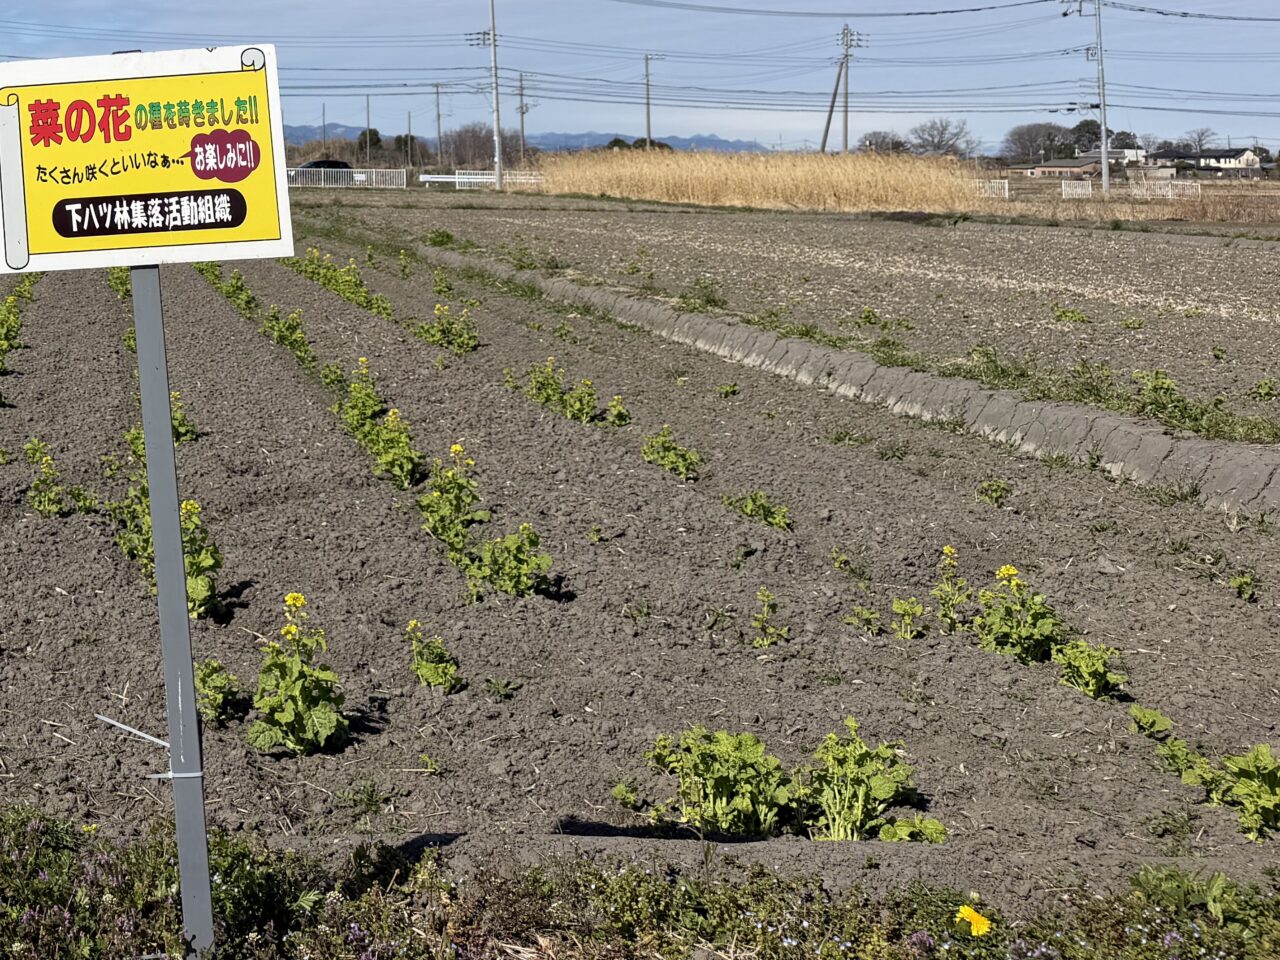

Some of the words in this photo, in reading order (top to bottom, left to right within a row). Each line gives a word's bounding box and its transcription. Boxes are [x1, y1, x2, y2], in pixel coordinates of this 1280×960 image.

[195, 142, 255, 171] お楽しみに!!
[65, 195, 232, 232] 下八ツ林集落活動組織
